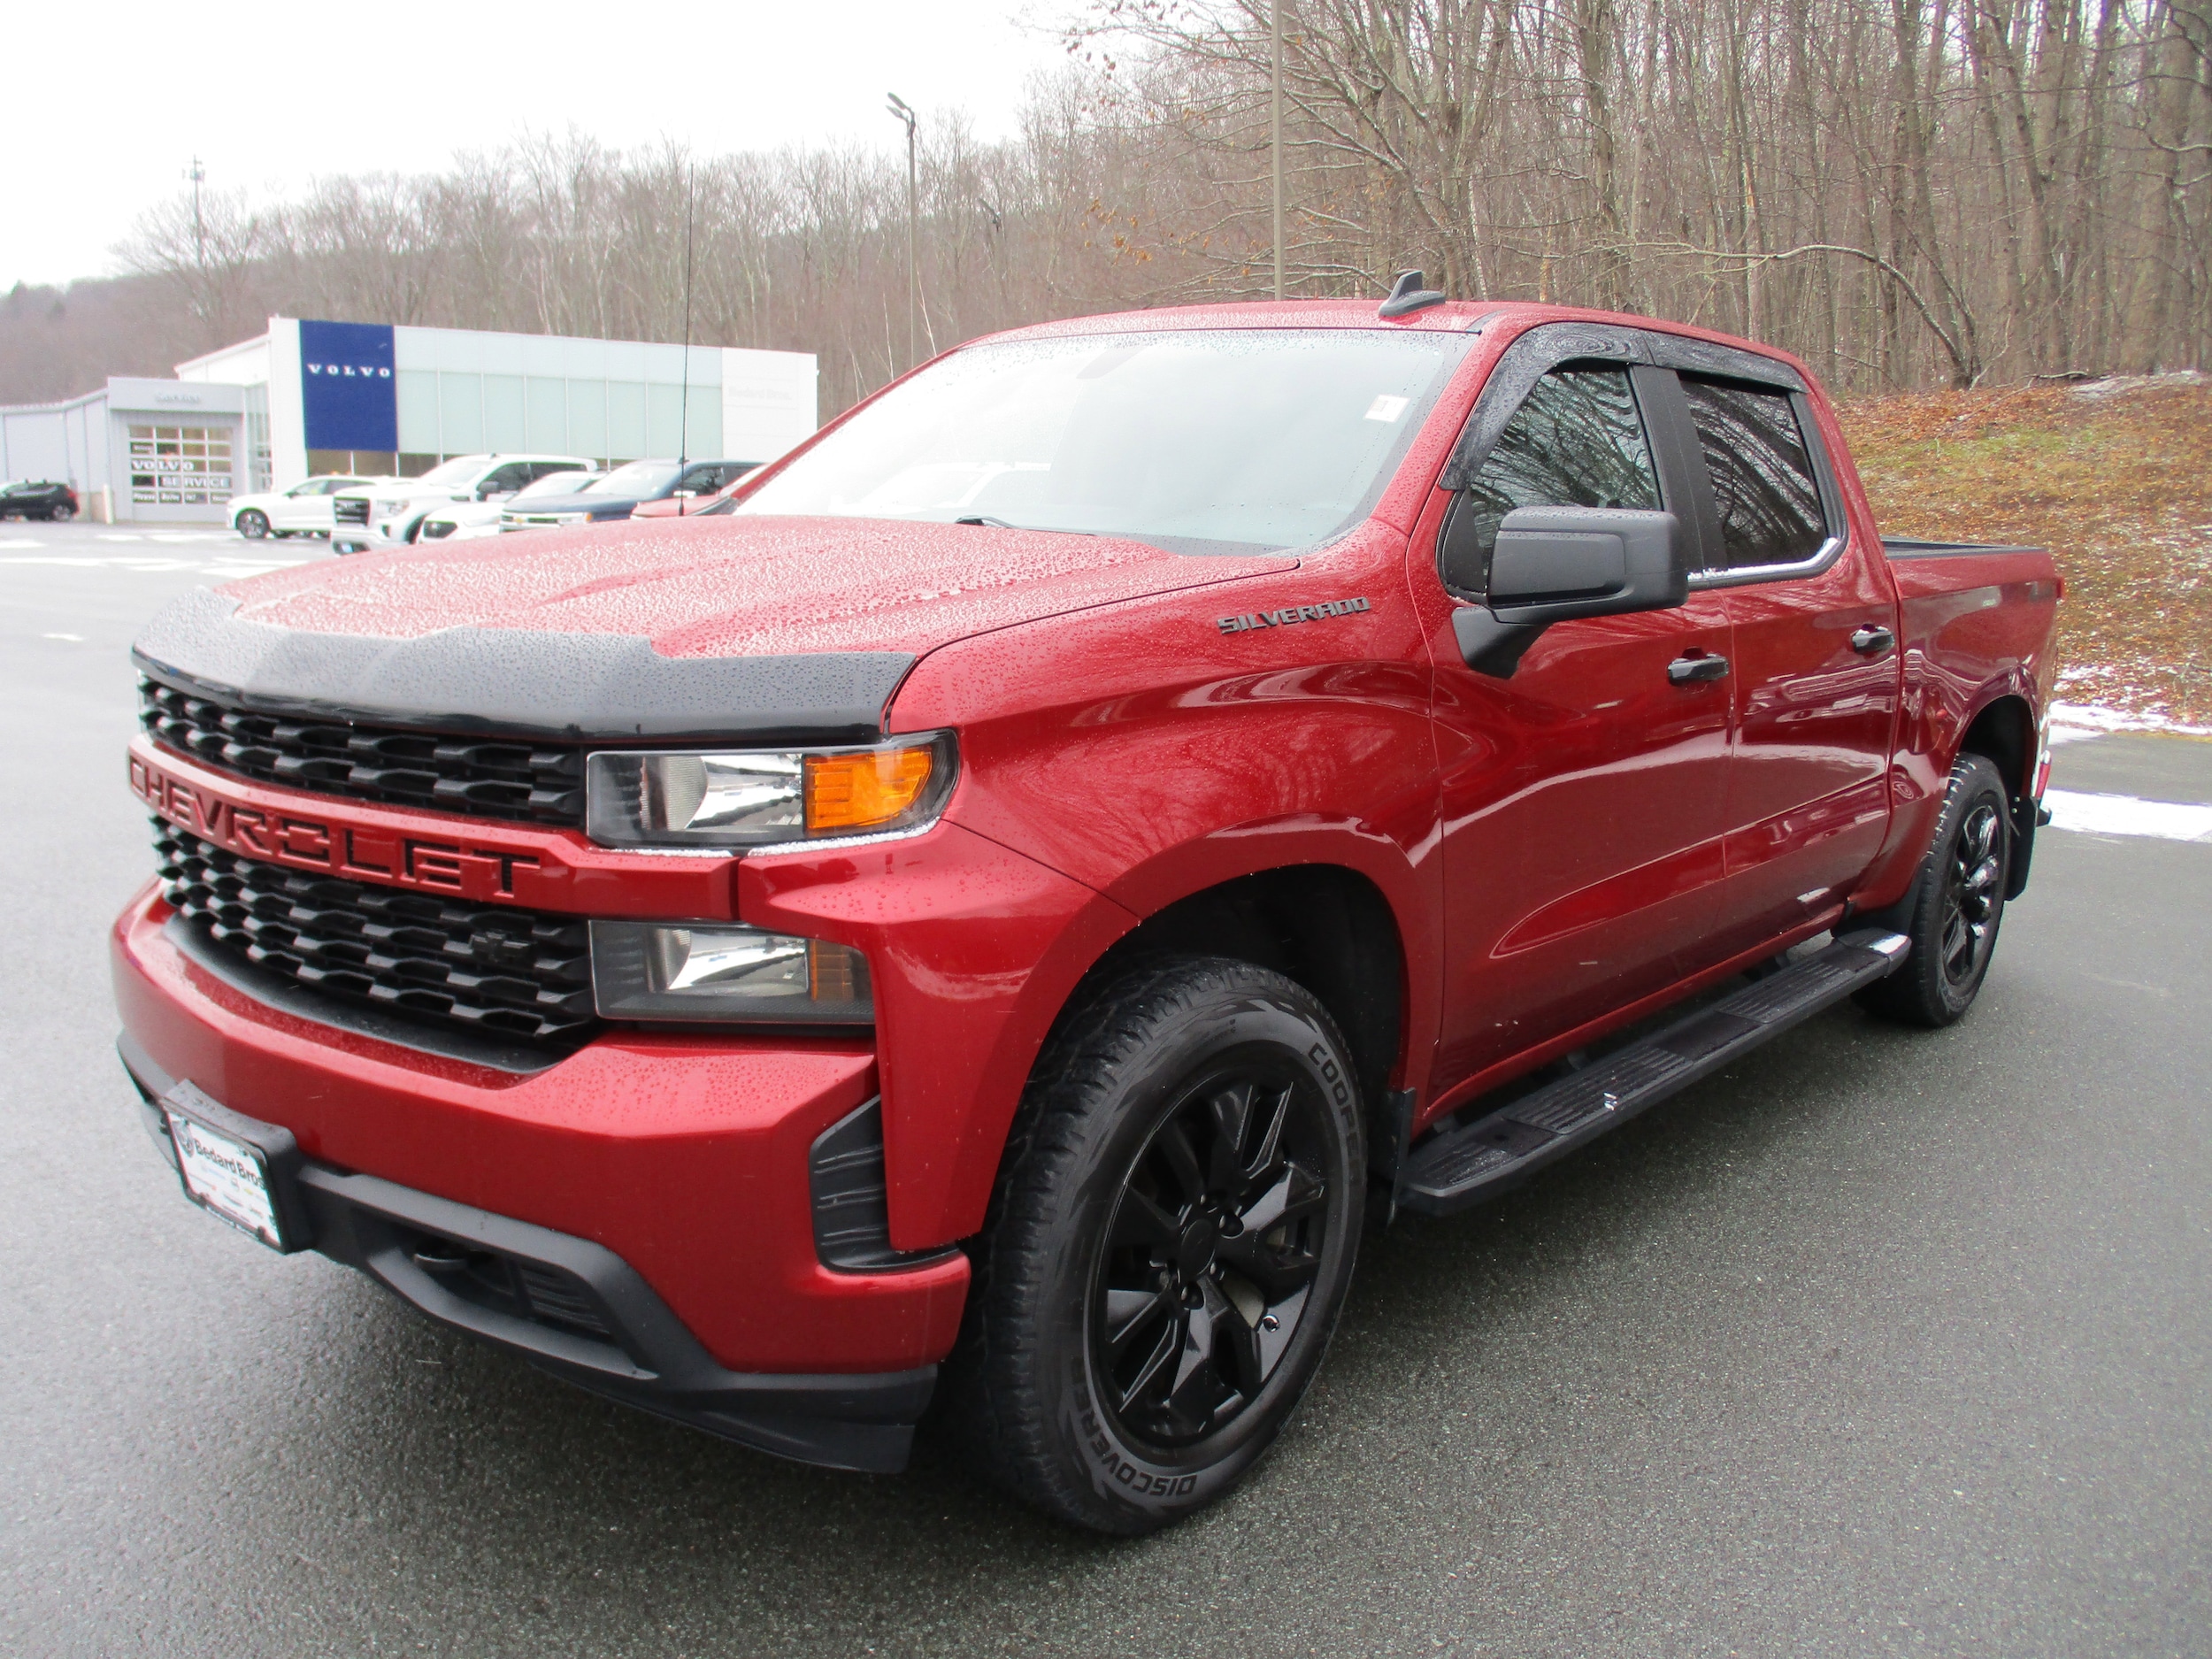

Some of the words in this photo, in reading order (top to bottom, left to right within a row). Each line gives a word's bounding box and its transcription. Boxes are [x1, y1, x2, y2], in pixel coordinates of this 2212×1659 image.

[306, 363, 391, 379] VOLVO
[131, 458, 195, 472] VOLVO
[162, 476, 230, 488] SERVICE
[1217, 596, 1371, 635] SILVERADO
[128, 757, 541, 900] CHEVROLET
[194, 1138, 236, 1174] Bedard
